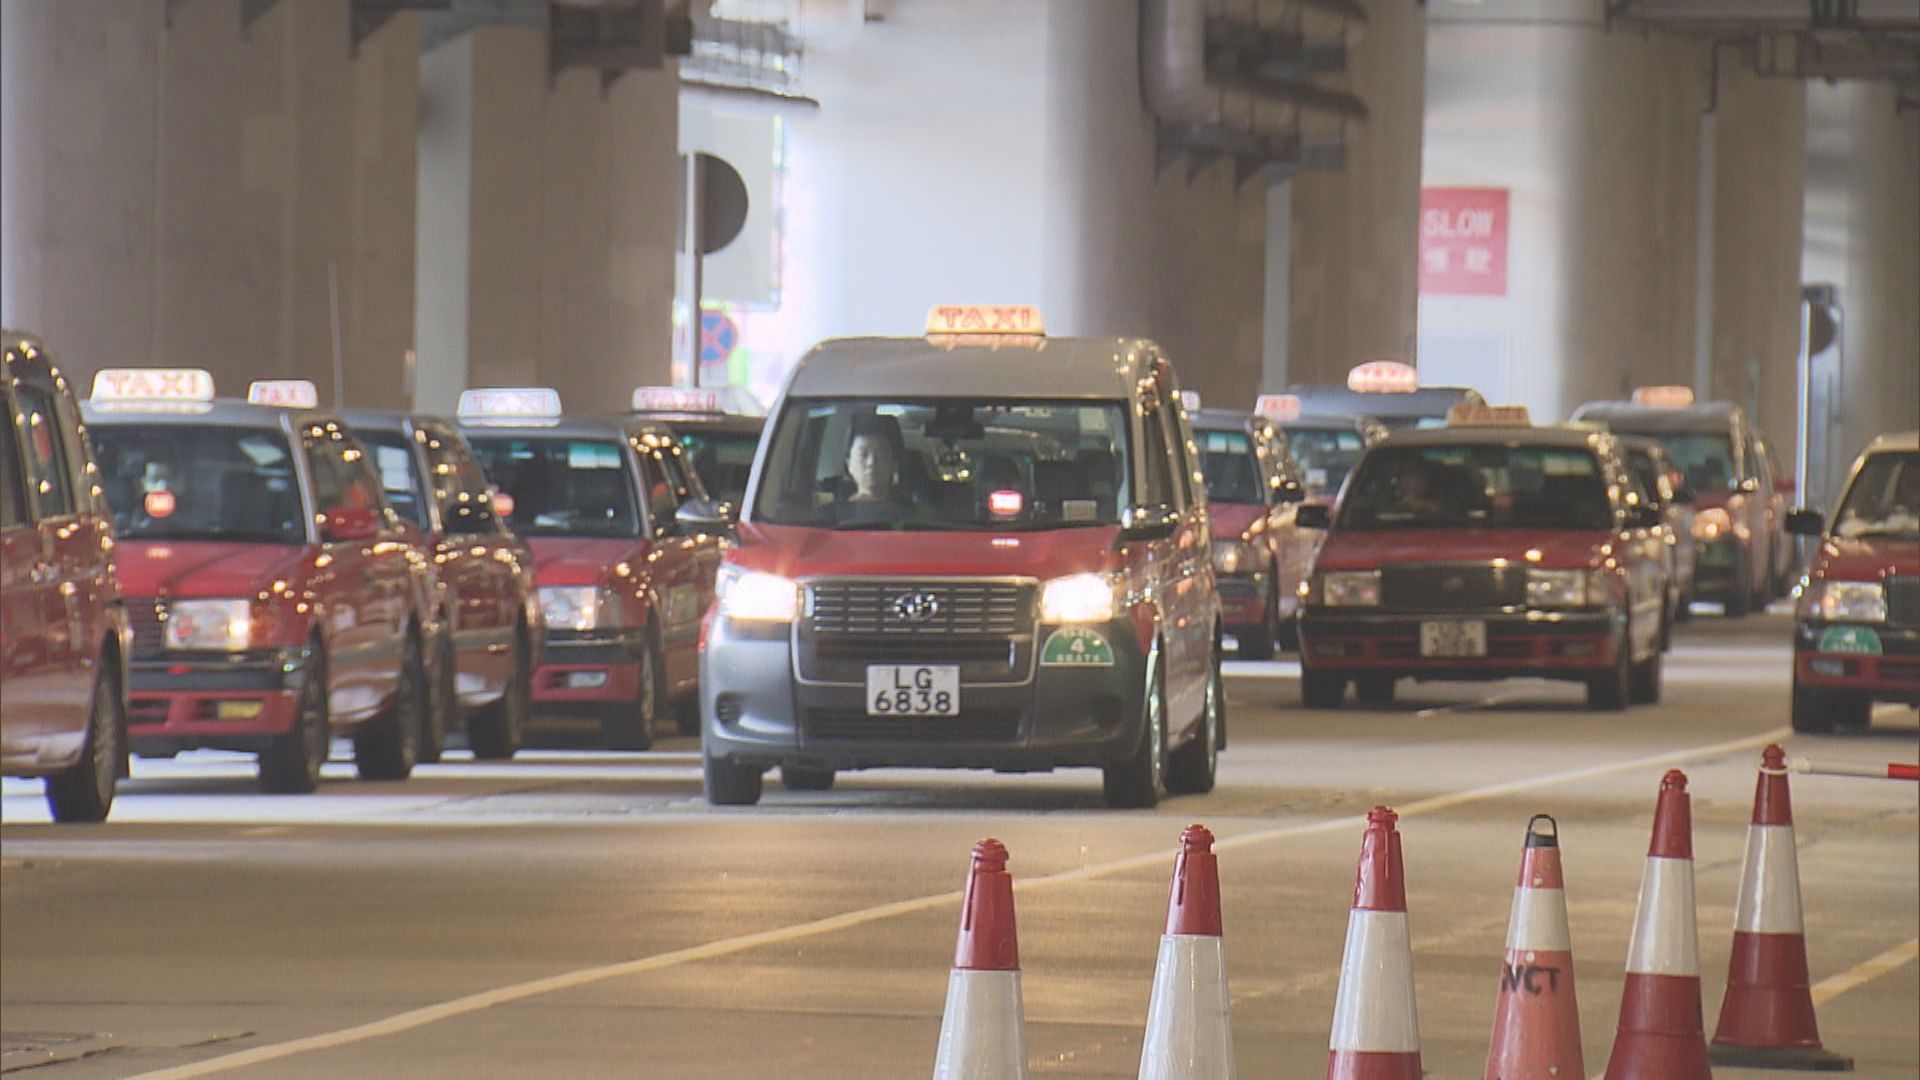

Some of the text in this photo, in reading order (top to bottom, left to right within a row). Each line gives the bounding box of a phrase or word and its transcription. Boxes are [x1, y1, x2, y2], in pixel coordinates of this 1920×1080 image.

[1423, 207, 1494, 238] SLOW
[938, 306, 1031, 331] TAXI
[105, 372, 199, 396] TAXI
[256, 385, 309, 402] TAXI
[471, 394, 550, 415] TAXI
[1070, 638, 1085, 655] 4
[894, 668, 932, 689] LG
[874, 691, 951, 713] 6838
